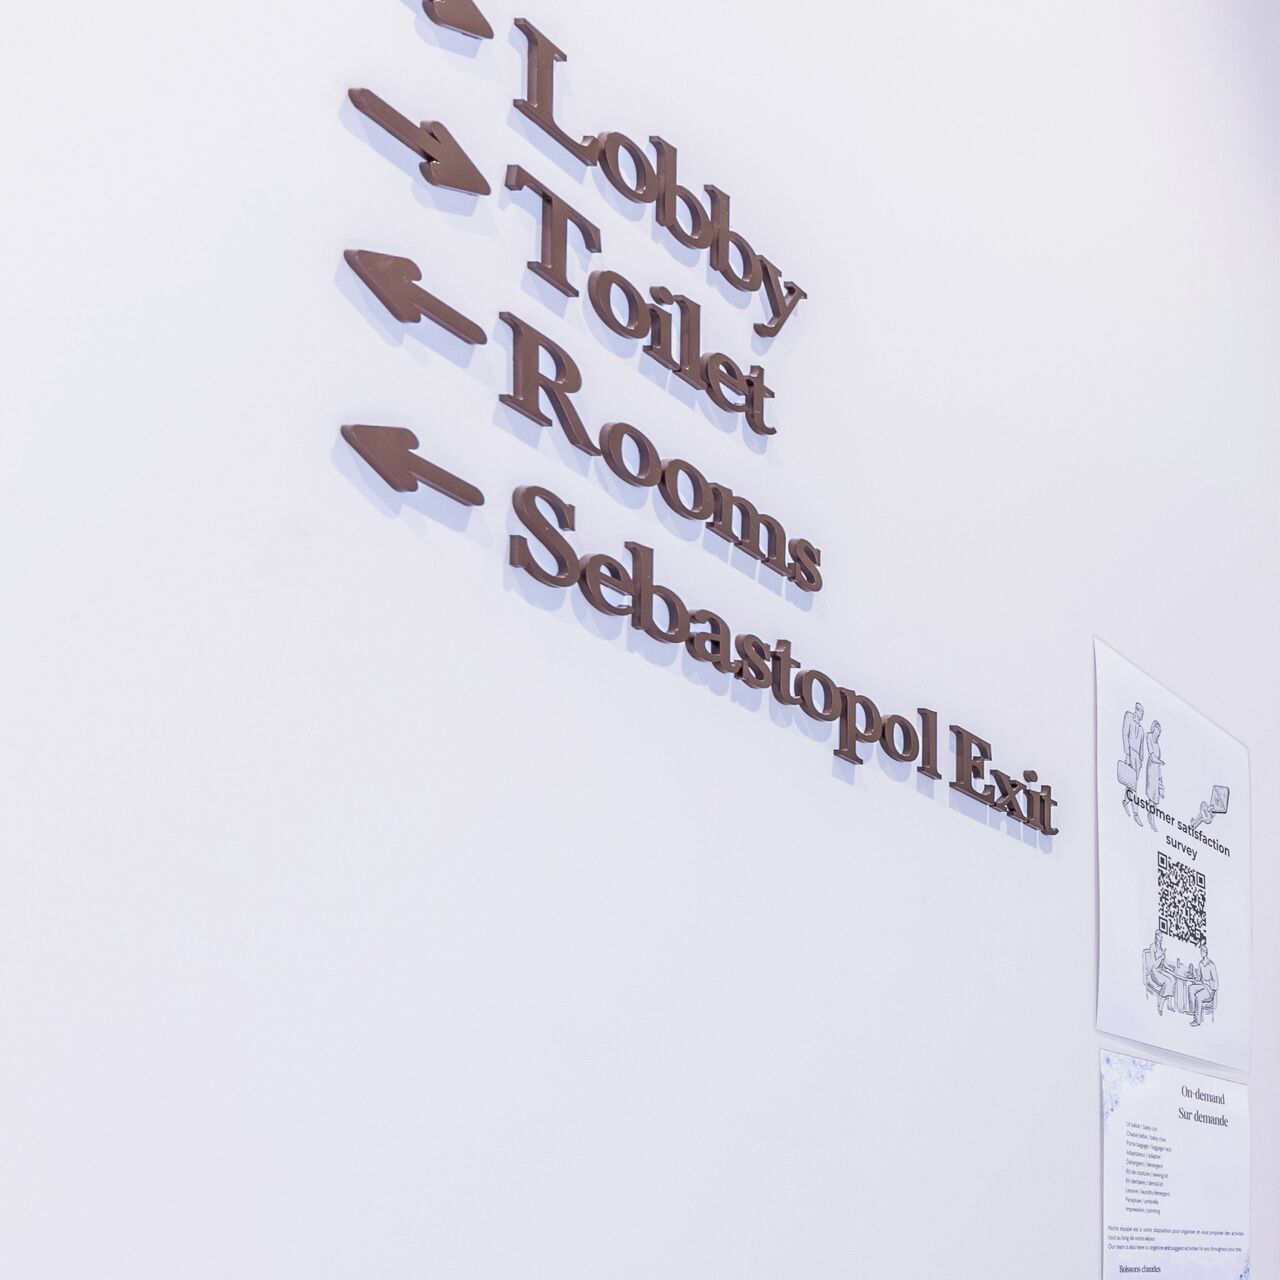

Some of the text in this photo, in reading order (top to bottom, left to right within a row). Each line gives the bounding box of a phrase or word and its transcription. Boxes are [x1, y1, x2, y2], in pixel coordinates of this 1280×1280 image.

[513, 17, 807, 338] Lobby
[506, 164, 777, 436] Toilet
[499, 310, 822, 593] Rooms
[510, 484, 1059, 836] Sebastopol Exit
[1126, 789, 1230, 858] Customer satisfaction
[1166, 835, 1198, 861] survey
[1178, 1107, 1228, 1127] Sur demande
[1181, 1085, 1225, 1104] On-demand
